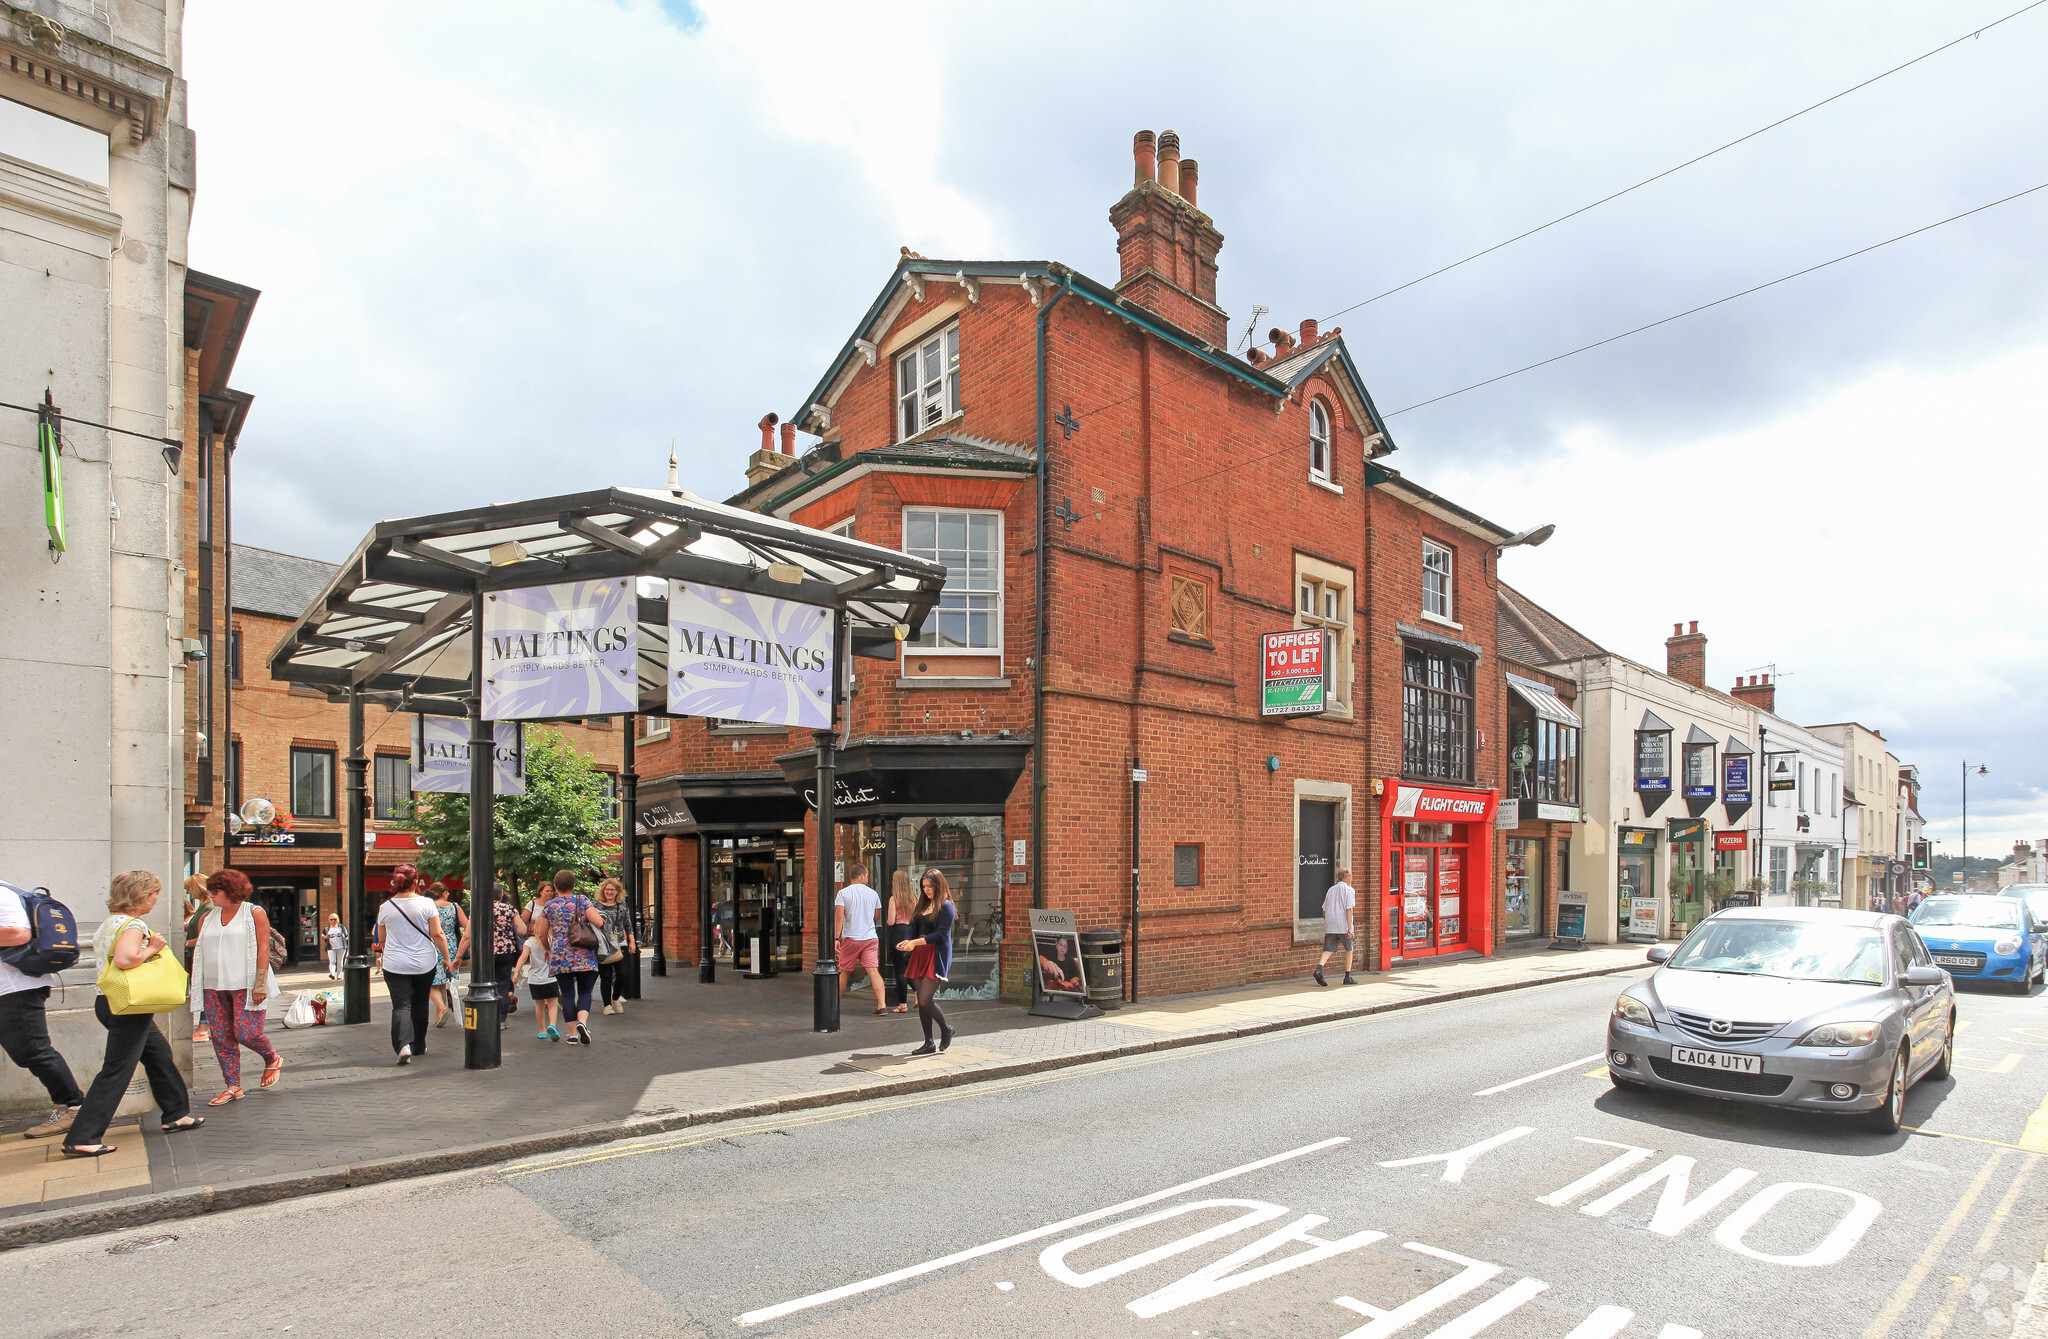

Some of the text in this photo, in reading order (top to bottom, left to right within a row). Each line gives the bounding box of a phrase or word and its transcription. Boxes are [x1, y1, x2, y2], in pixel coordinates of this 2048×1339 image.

[491, 626, 627, 661] MALTINGS
[1269, 632, 1320, 648] OFFICES
[679, 628, 825, 673] MALTINGS
[1268, 648, 1319, 666] TO LET
[510, 658, 605, 673] SIMPLY YARDS BETTER
[703, 661, 804, 683] SIMPLY YARDS BETTER
[418, 743, 518, 763] MALTGS
[651, 805, 669, 814] HOTEL
[1420, 796, 1486, 814] FLIGHT CENTRE
[1673, 825, 1701, 839] SUBWAY
[1037, 914, 1067, 924] AVEDA
[1935, 956, 1957, 964] LR60
[1678, 1049, 1753, 1071] CA04 UTV
[1376, 1126, 1883, 1267] ONLY
